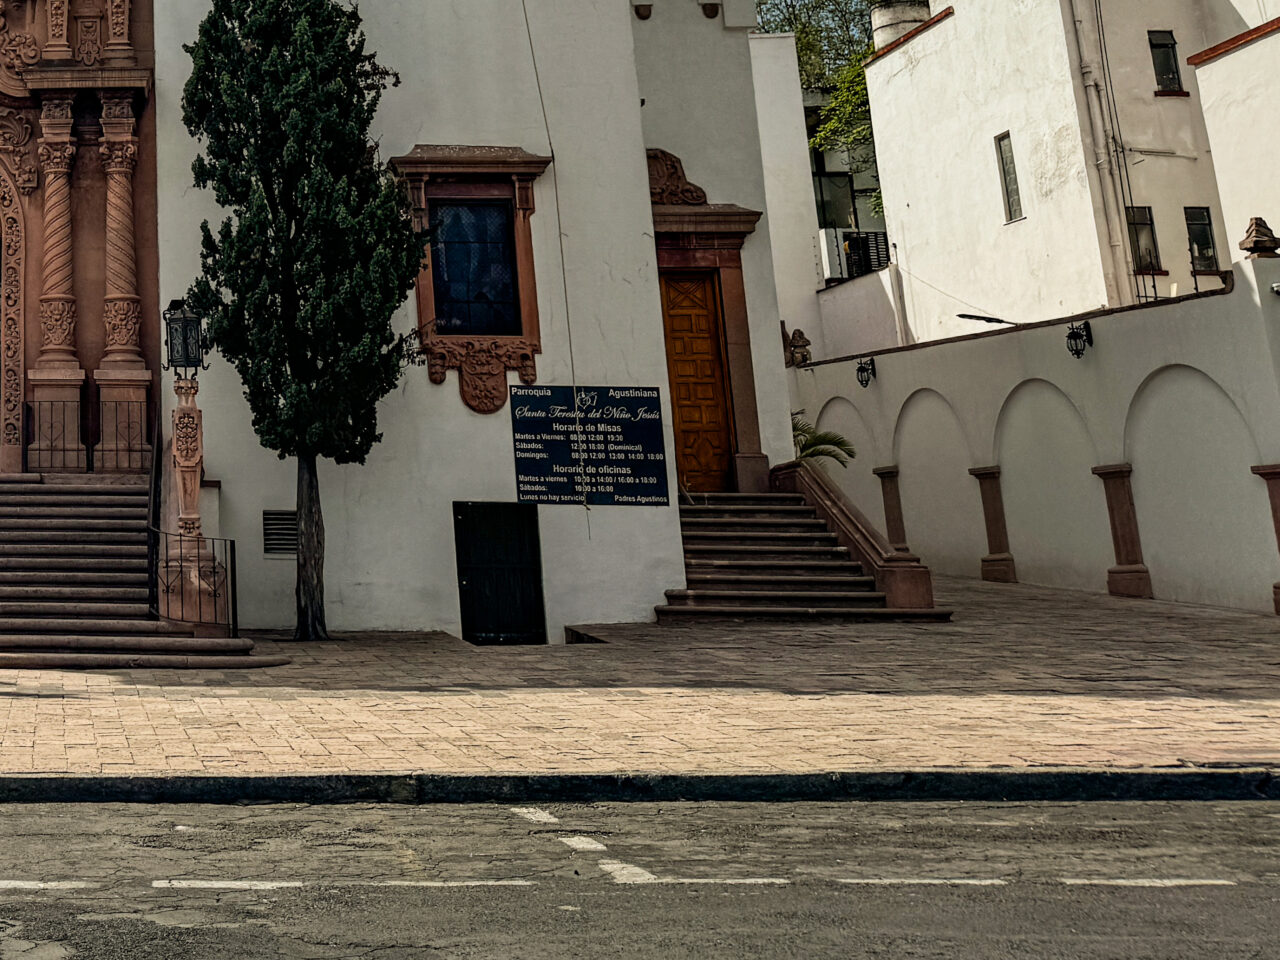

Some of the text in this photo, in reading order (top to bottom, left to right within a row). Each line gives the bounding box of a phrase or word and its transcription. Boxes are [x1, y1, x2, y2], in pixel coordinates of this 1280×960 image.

[512, 388, 551, 398] Parroquia
[609, 389, 658, 398] Agustiniana
[515, 406, 546, 419] Santa
[588, 410, 601, 418] del
[603, 406, 632, 418] Niño
[632, 407, 659, 421] Jesús
[553, 424, 583, 432] Horario
